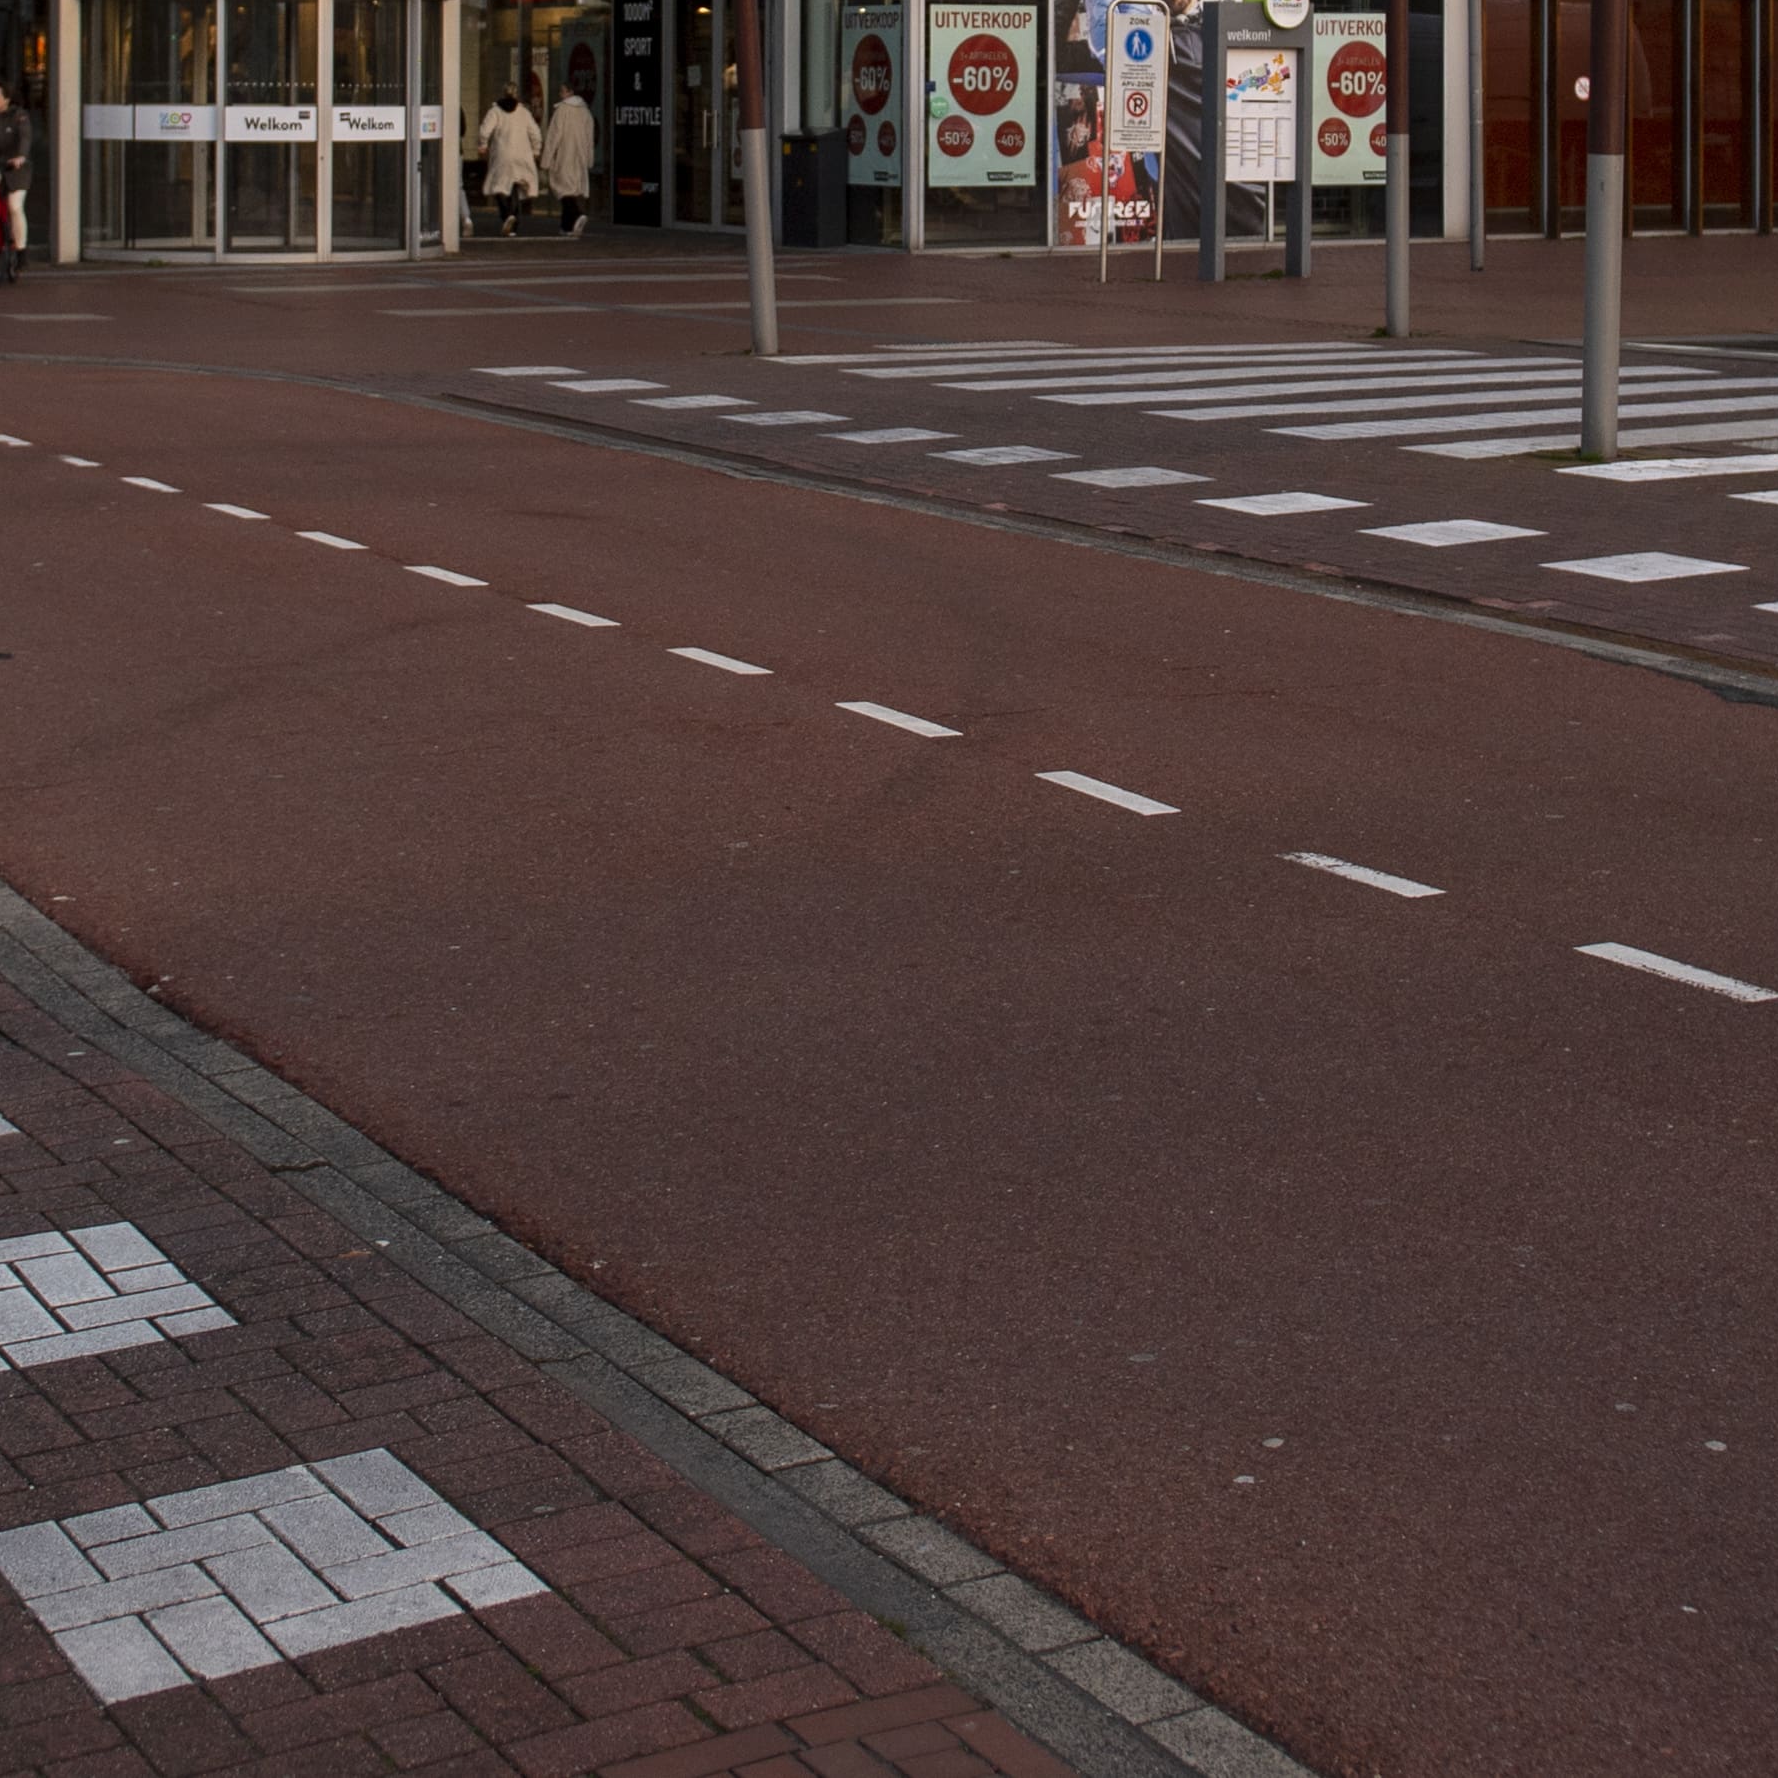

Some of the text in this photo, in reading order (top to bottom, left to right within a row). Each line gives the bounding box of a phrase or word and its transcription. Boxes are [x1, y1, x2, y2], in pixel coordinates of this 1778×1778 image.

[845, 12, 899, 30] UITVERKOOP
[935, 11, 1033, 29] UITVERKOOP
[1129, 17, 1151, 25] ZONE
[1227, 29, 1272, 41] welkom!
[1316, 20, 1386, 36] UITVERKO
[624, 37, 652, 56] SPORT
[855, 66, 889, 91] -60%
[953, 66, 1014, 92] -60%
[1121, 80, 1155, 88] APV-ZONE
[1331, 71, 1386, 95] -60%
[616, 106, 661, 125] LIFESTYLE
[244, 116, 302, 131] Welkom
[348, 116, 395, 131] Welkom
[939, 131, 971, 145] -50%
[997, 133, 1023, 146] -40%
[1320, 133, 1348, 146] -50%
[1371, 136, 1386, 147] -40
